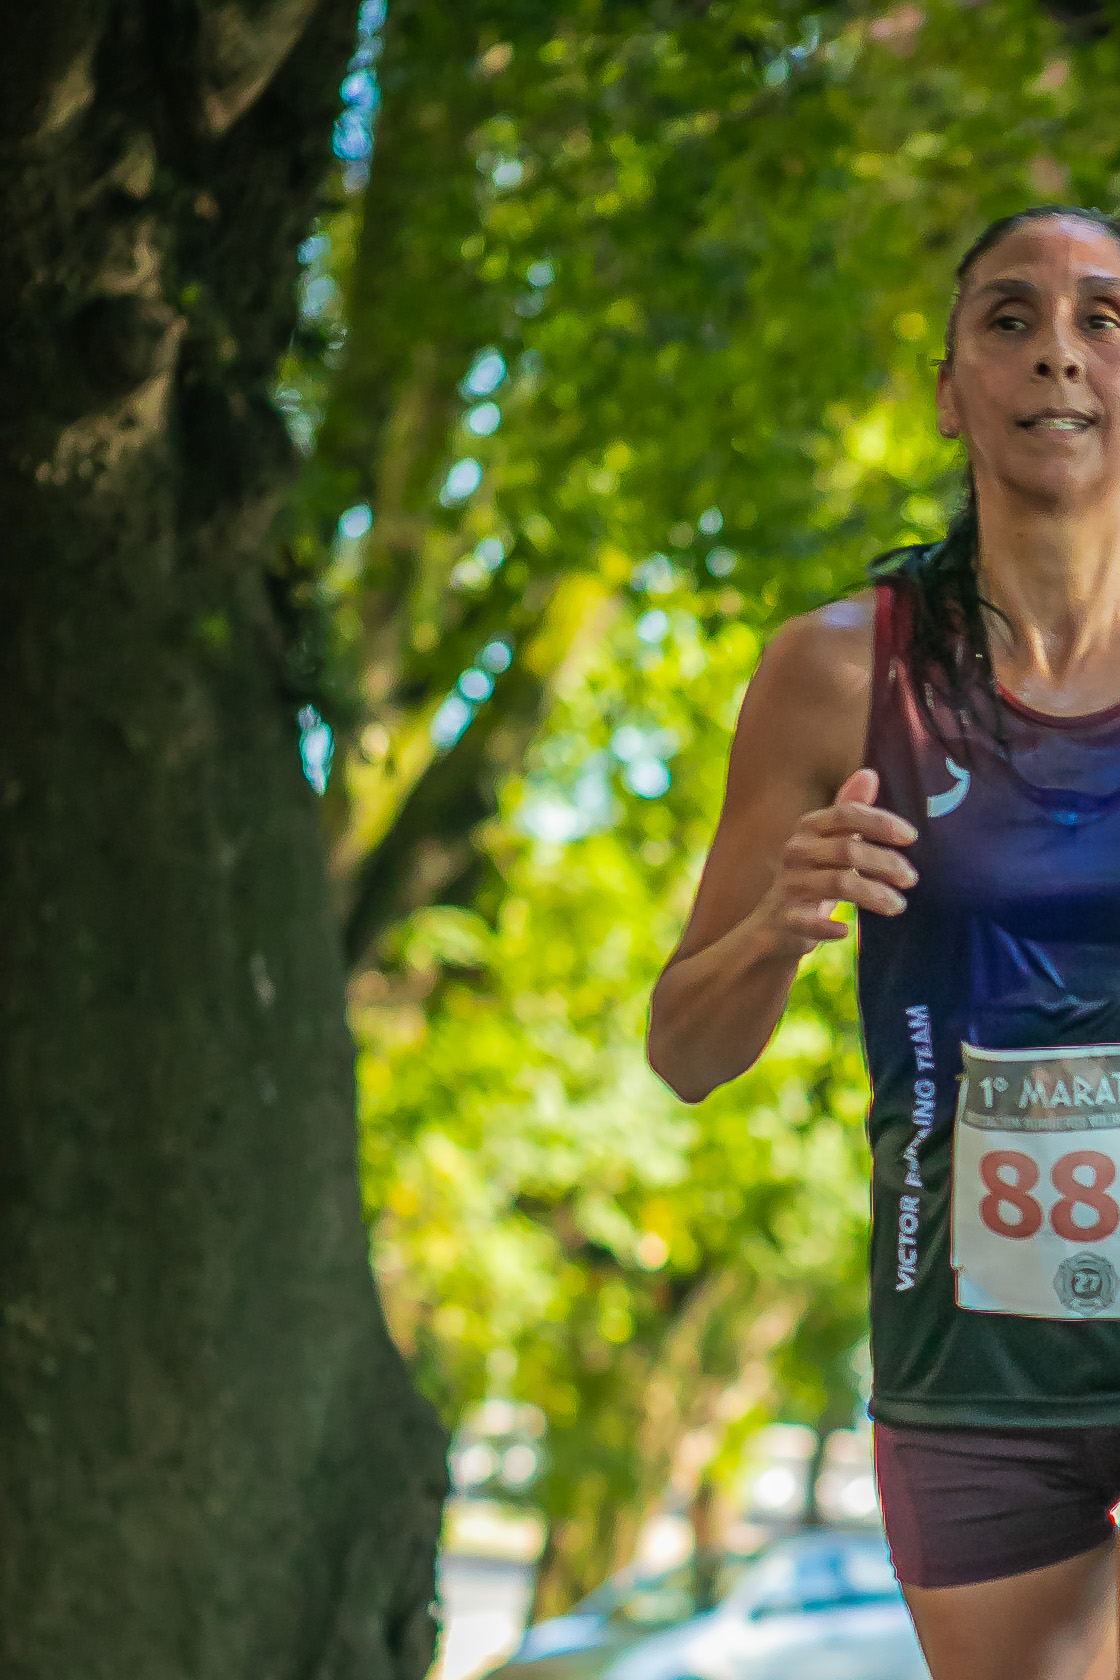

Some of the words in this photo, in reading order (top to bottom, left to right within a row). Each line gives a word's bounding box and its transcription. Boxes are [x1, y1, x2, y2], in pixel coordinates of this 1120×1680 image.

[905, 1004, 934, 1071] TEAM
[903, 1079, 936, 1188] RING
[896, 1195, 920, 1292] VICTOR
[1074, 1271, 1100, 1293] 27
